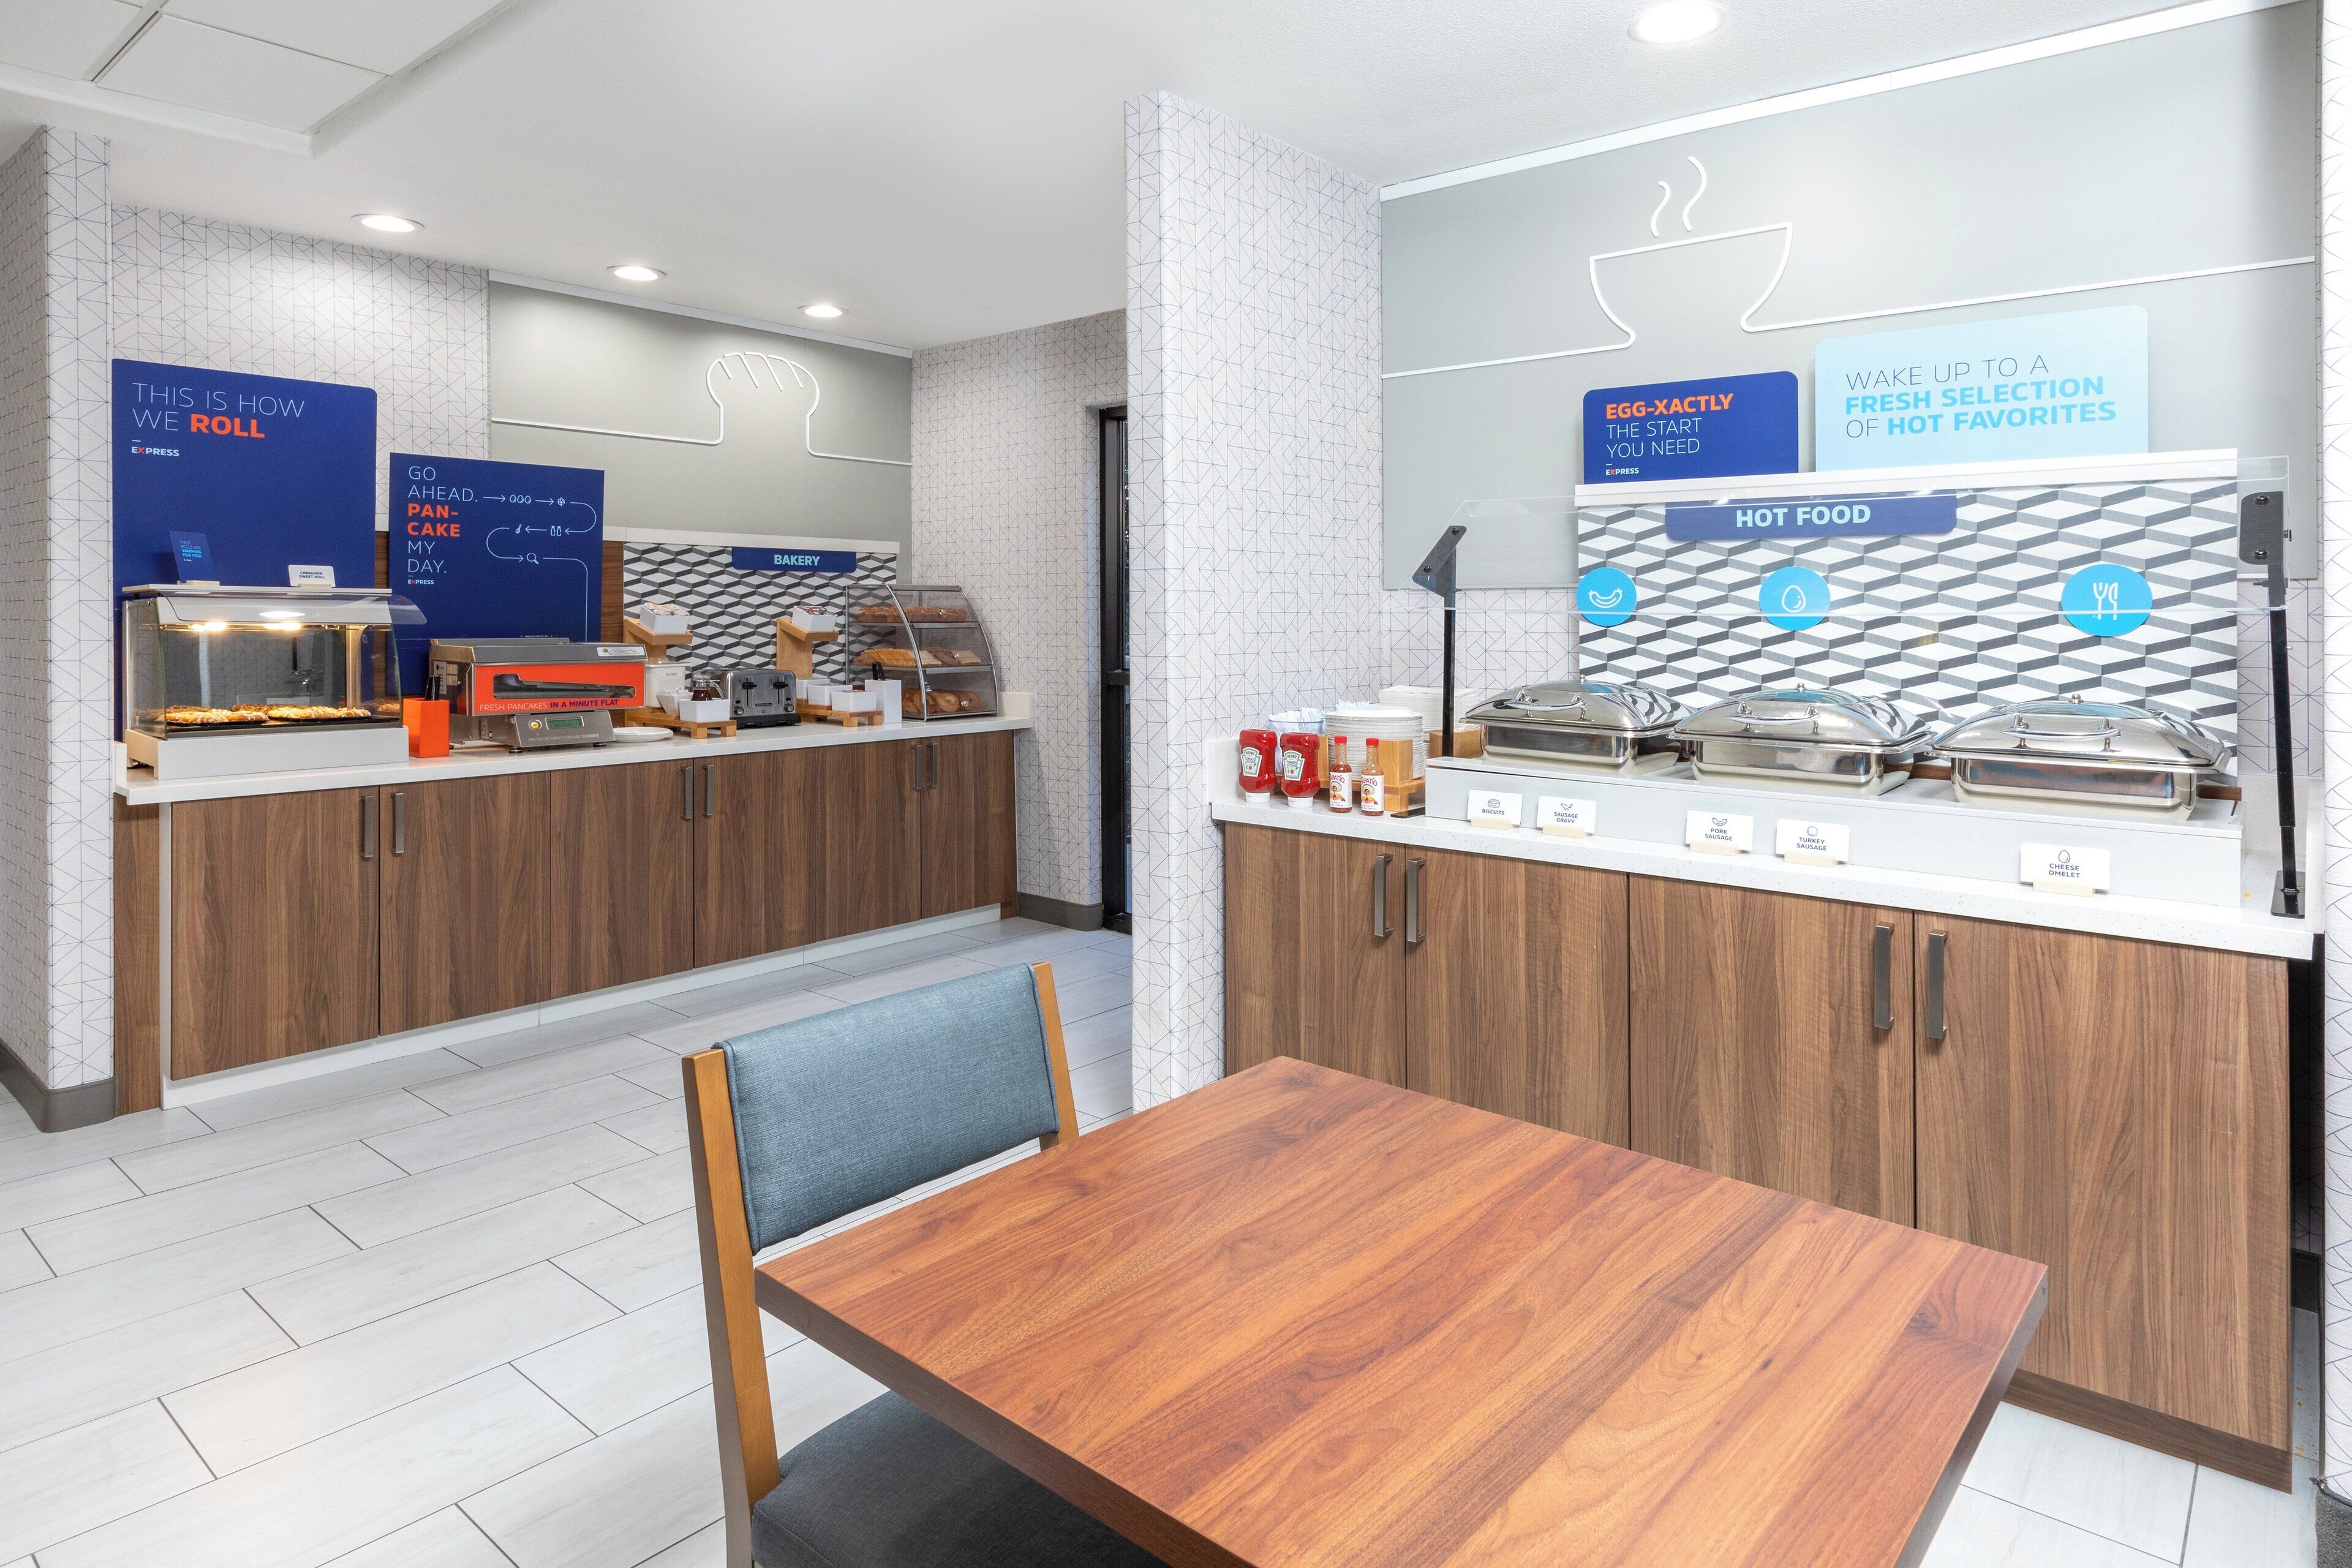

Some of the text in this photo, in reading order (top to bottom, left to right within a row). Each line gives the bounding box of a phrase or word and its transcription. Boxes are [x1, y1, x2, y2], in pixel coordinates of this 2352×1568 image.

[1846, 355, 2049, 391] WAKE UP TO A
[132, 383, 304, 418] THIS IS HOW
[1845, 375, 2103, 415] FRESH SELECTION
[1606, 393, 1734, 420] EGG-XACTLY
[132, 408, 265, 438] WE ROLL
[1846, 401, 2116, 438] OF HOT FAVORITES
[1606, 417, 1702, 439] THE START
[132, 446, 179, 457] EXPRESS
[1606, 438, 1700, 458] YOU NEED
[409, 466, 435, 481] GO
[1605, 467, 1639, 476] EXPRESS
[408, 484, 478, 502] AHEAD.
[408, 503, 458, 518] PAN-
[1736, 505, 1871, 527] HOT FOOD
[407, 522, 460, 537] CAKE
[409, 540, 435, 554] MY
[408, 559, 447, 573] DAY.
[774, 554, 820, 566] BAKERY
[1330, 774, 1345, 783] APATÍO
[1362, 777, 1378, 786] APATÍO
